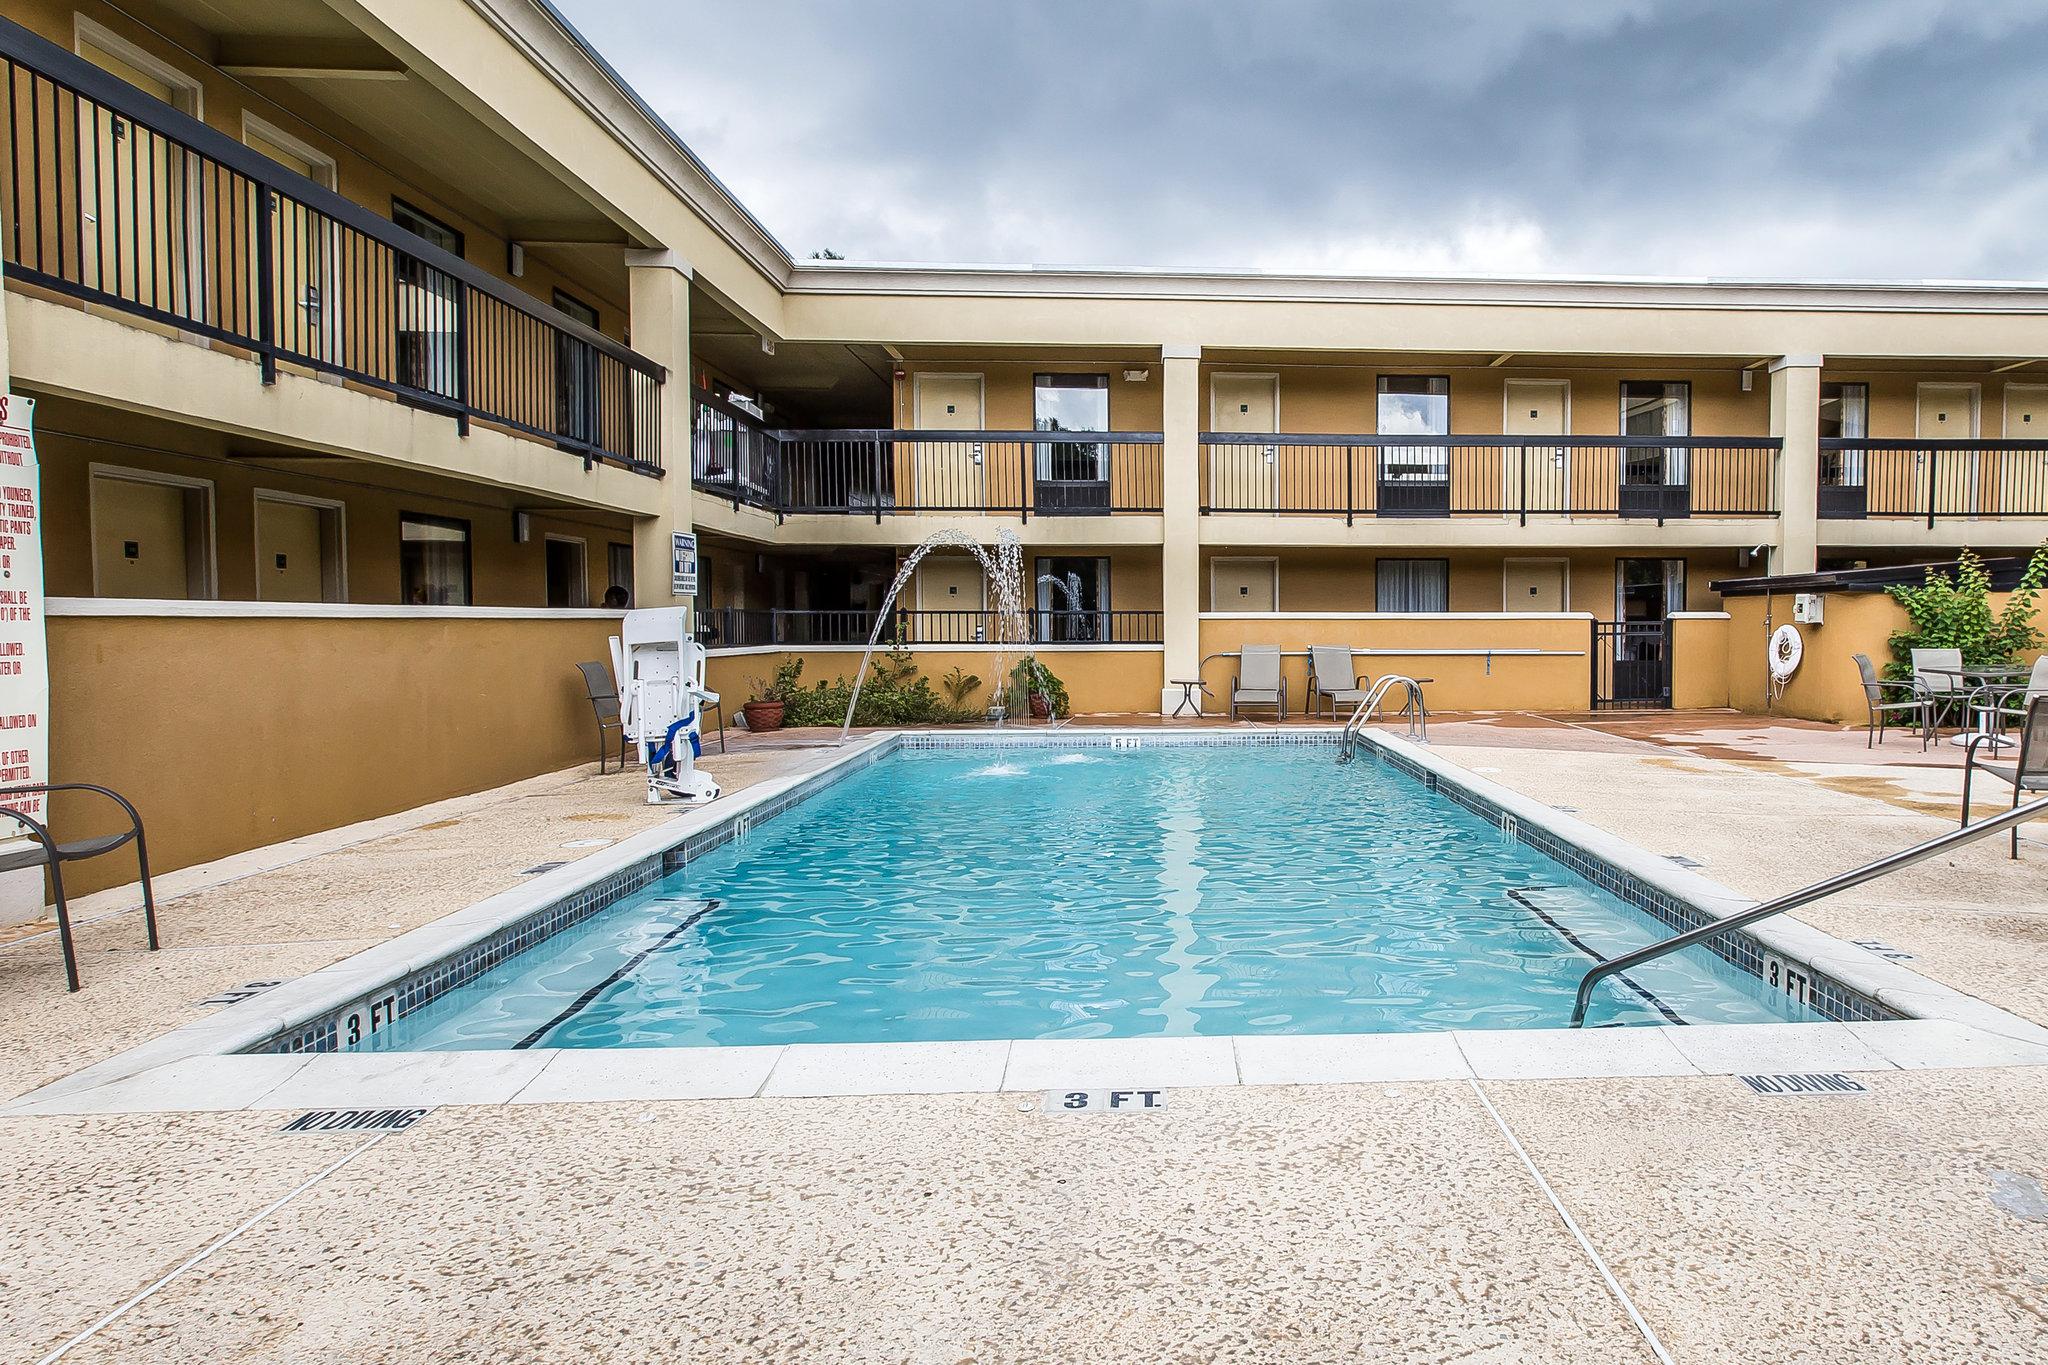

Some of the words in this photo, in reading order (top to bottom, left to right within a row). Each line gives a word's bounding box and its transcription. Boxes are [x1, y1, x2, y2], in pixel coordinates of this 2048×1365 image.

[10, 520, 31, 535] PANTS
[20, 591, 28, 604] BE
[9, 607, 17, 621] OF
[19, 607, 31, 621] THE
[13, 661, 21, 675] OR
[28, 713, 36, 728] ON
[2, 751, 9, 766] OF
[11, 749, 29, 765] OTHER
[33, 798, 40, 812] BE
[1770, 960, 1779, 988] 3
[347, 1013, 361, 1046] 3
[1739, 1074, 1784, 1093] NO
[1771, 1073, 1867, 1092] DIVING
[1063, 1091, 1089, 1109] 3
[1110, 1090, 1162, 1108] FT.
[279, 1110, 337, 1132] NO
[318, 1108, 428, 1131] DIVING
